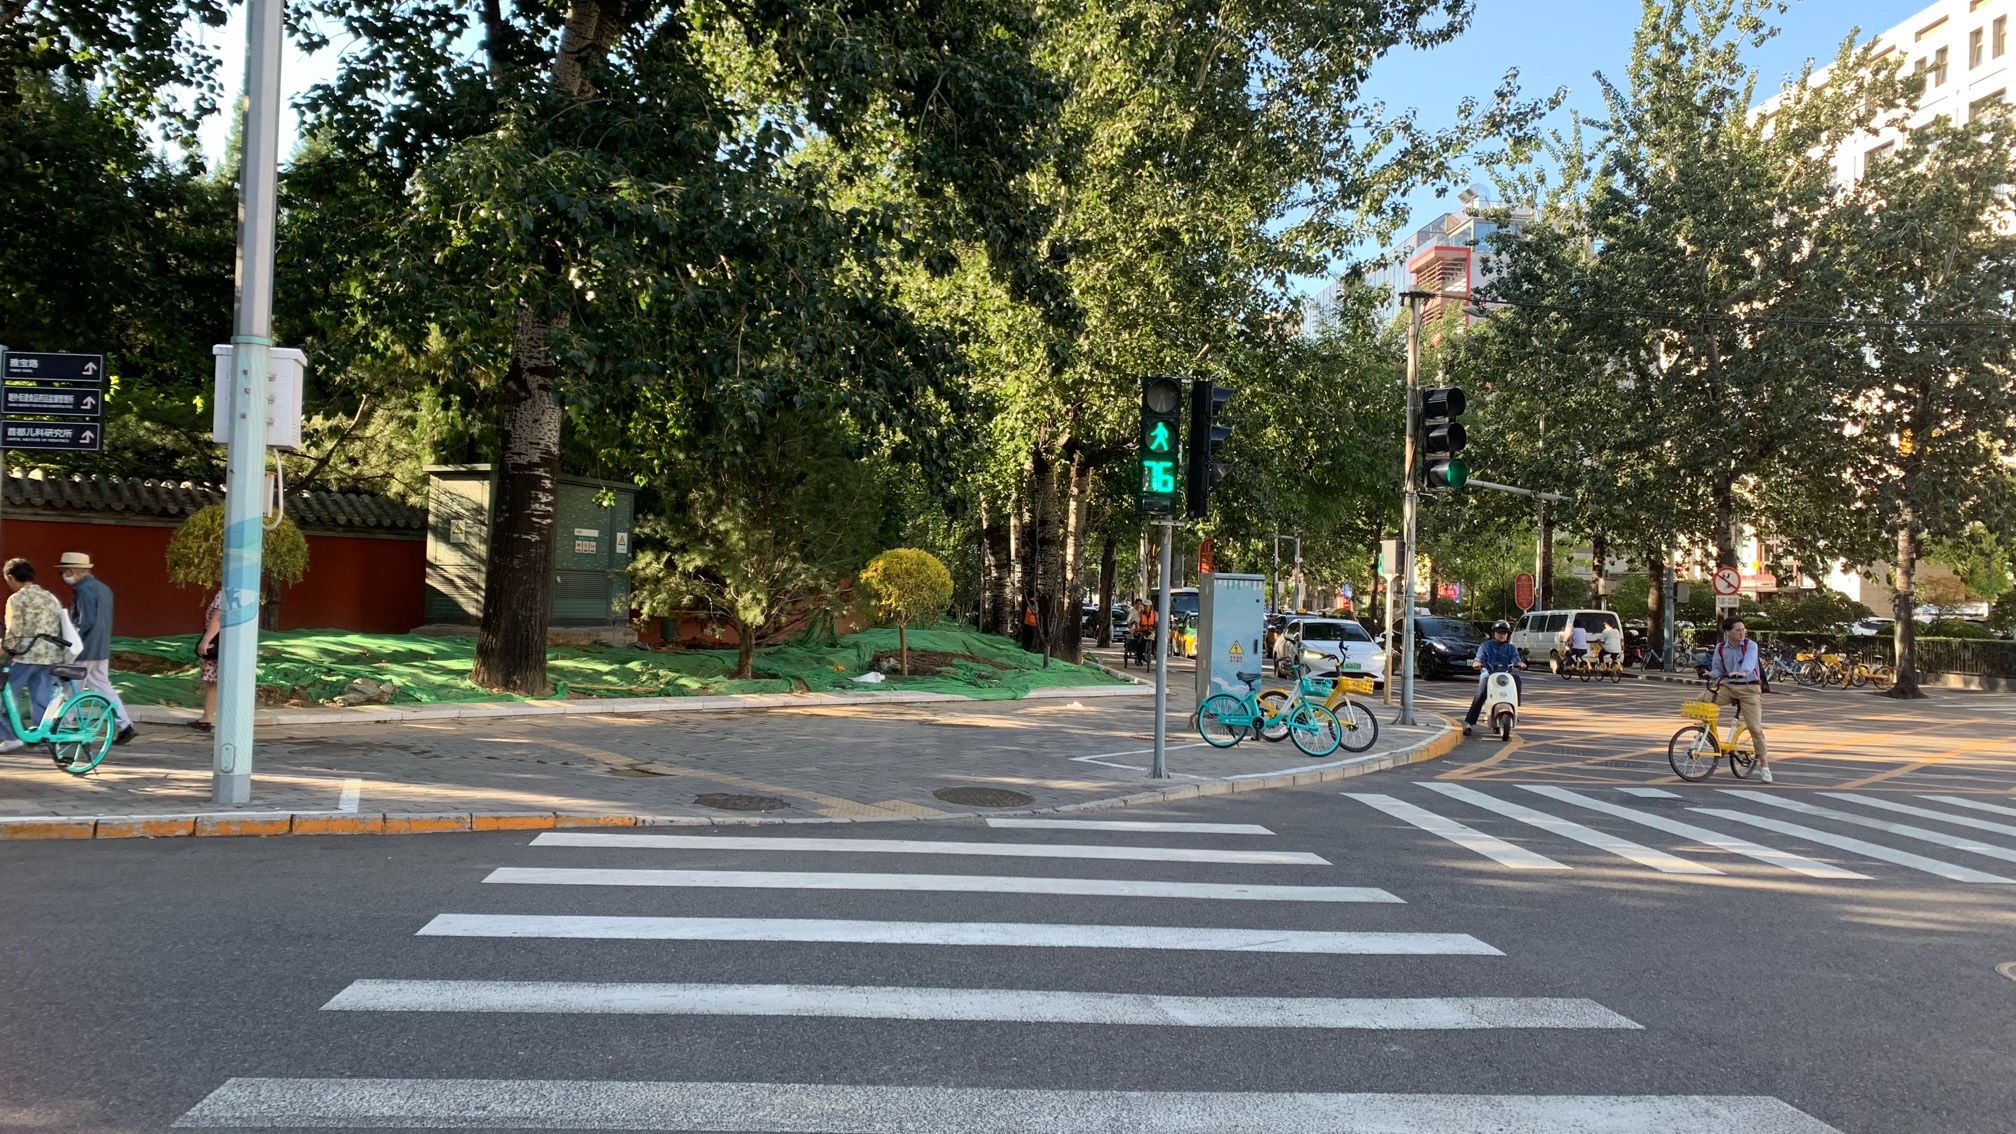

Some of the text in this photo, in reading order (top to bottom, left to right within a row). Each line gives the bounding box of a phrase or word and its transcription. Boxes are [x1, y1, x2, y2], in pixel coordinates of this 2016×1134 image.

[7, 427, 73, 438] 首都儿科研究所
[1143, 460, 1174, 493] 76
